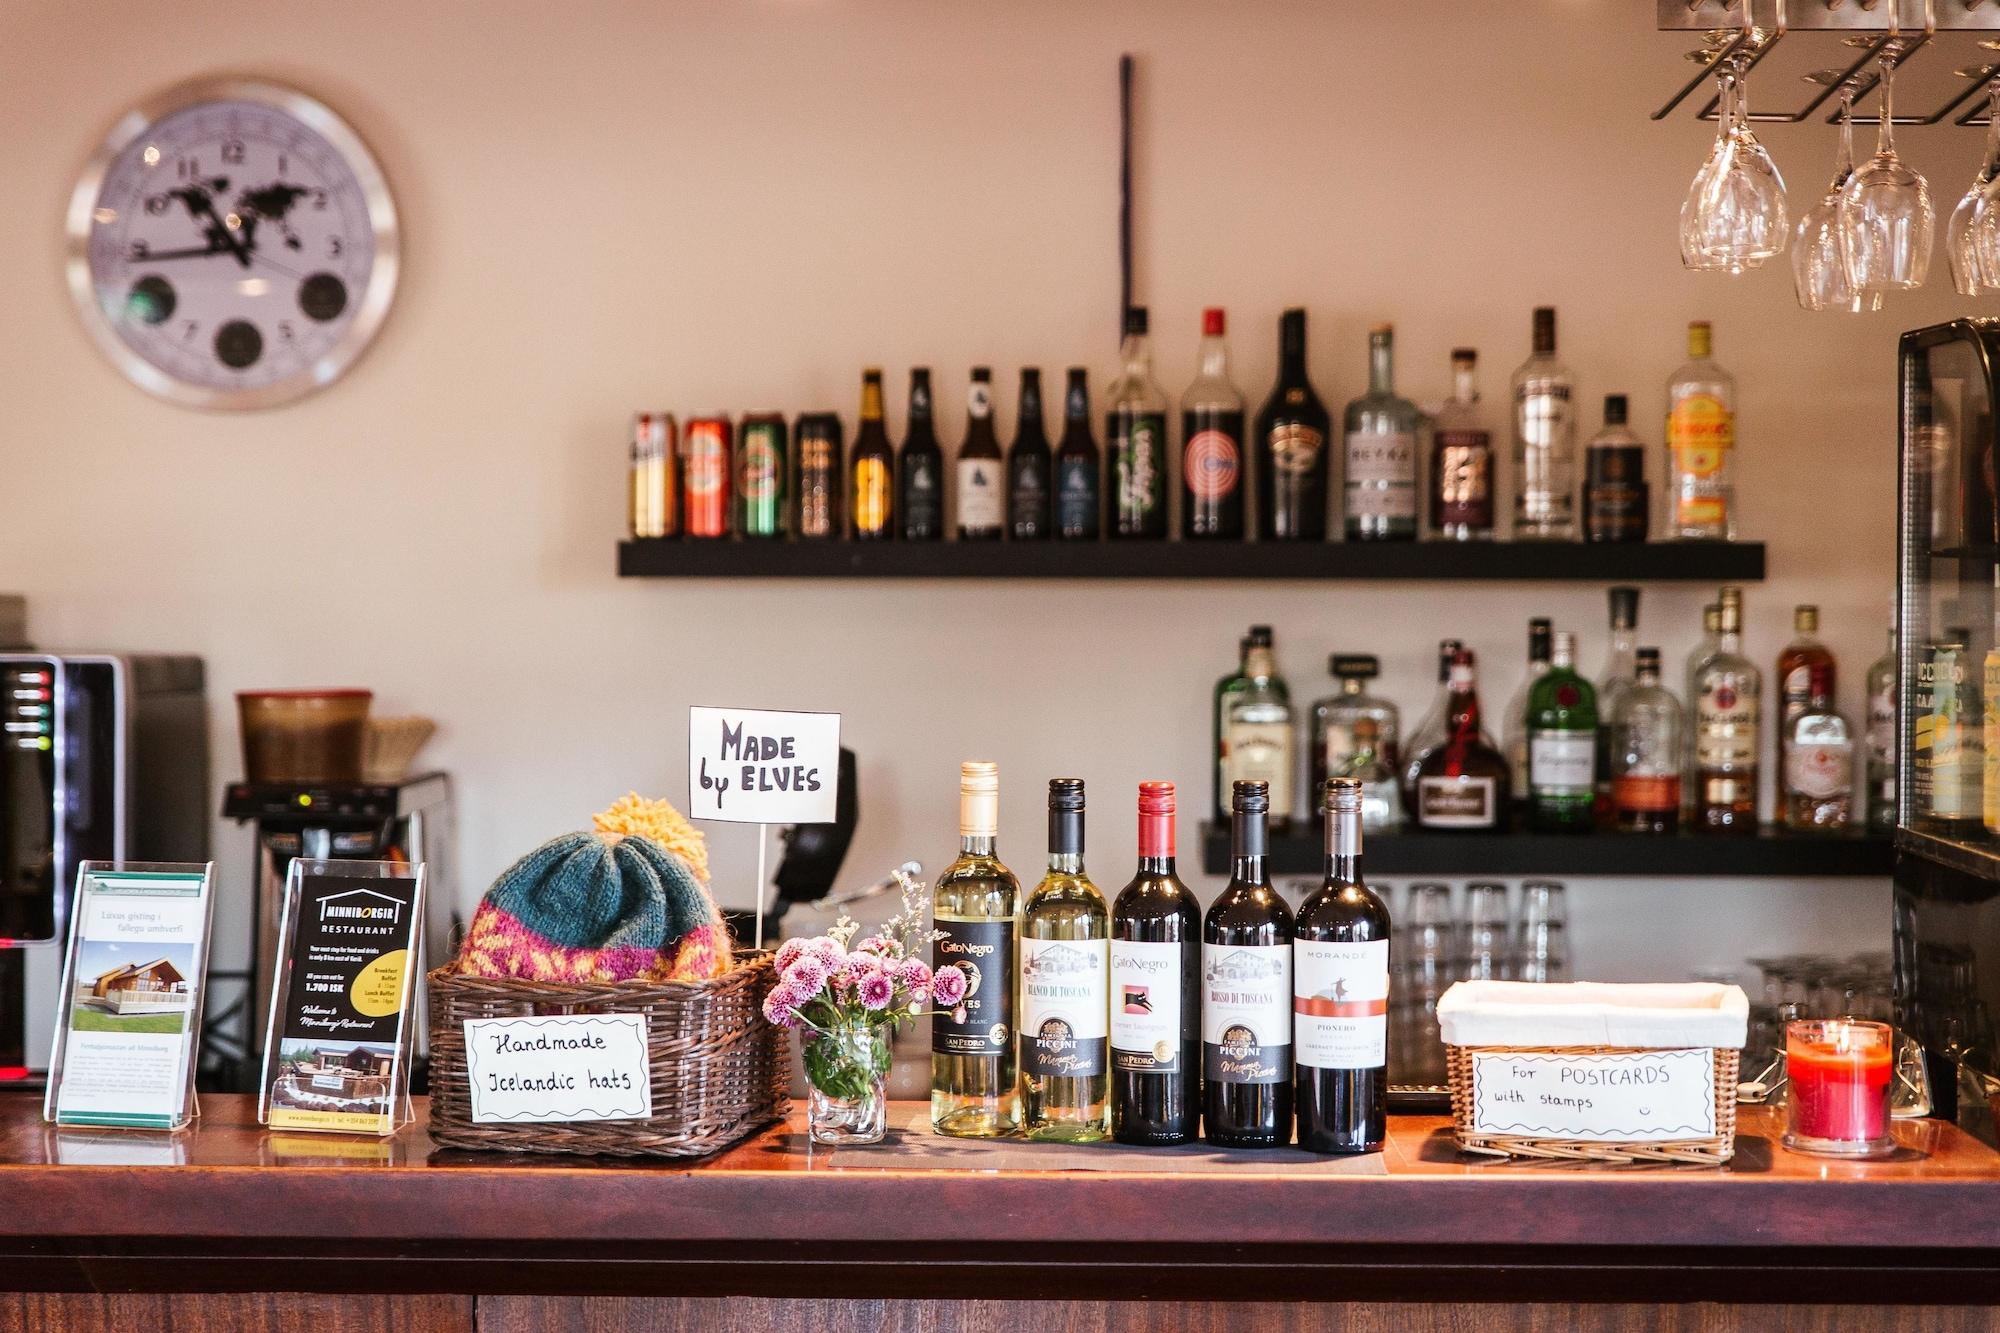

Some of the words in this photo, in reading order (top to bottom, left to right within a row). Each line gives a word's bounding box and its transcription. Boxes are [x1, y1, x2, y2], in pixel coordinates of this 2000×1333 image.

[221, 140, 245, 164] 12
[720, 718, 796, 762] MADE
[700, 757, 729, 809] by
[741, 765, 821, 792] ELVES
[326, 906, 394, 919] MINNIBORGIR
[321, 925, 395, 935] RESTAURANT
[305, 982, 328, 992] 1.700
[329, 983, 344, 993] ISK
[1028, 984, 1049, 996] BIANCO
[1050, 985, 1059, 997] DI
[1060, 985, 1092, 998] TOSCANA
[1211, 990, 1230, 1004] ROSSO
[1231, 992, 1240, 1004] DI
[1241, 992, 1273, 1005] TOSCANA
[490, 1031, 607, 1055] Handmade
[1036, 1039, 1078, 1049] PICCINI
[1219, 1047, 1261, 1057] PICCINI
[489, 1071, 575, 1093] Icelandic
[587, 1068, 632, 1090] hats
[1512, 1065, 1537, 1079] For
[1561, 1065, 1671, 1086] POSTCARDS
[1494, 1090, 1525, 1103] with
[1540, 1094, 1593, 1112] stamps
